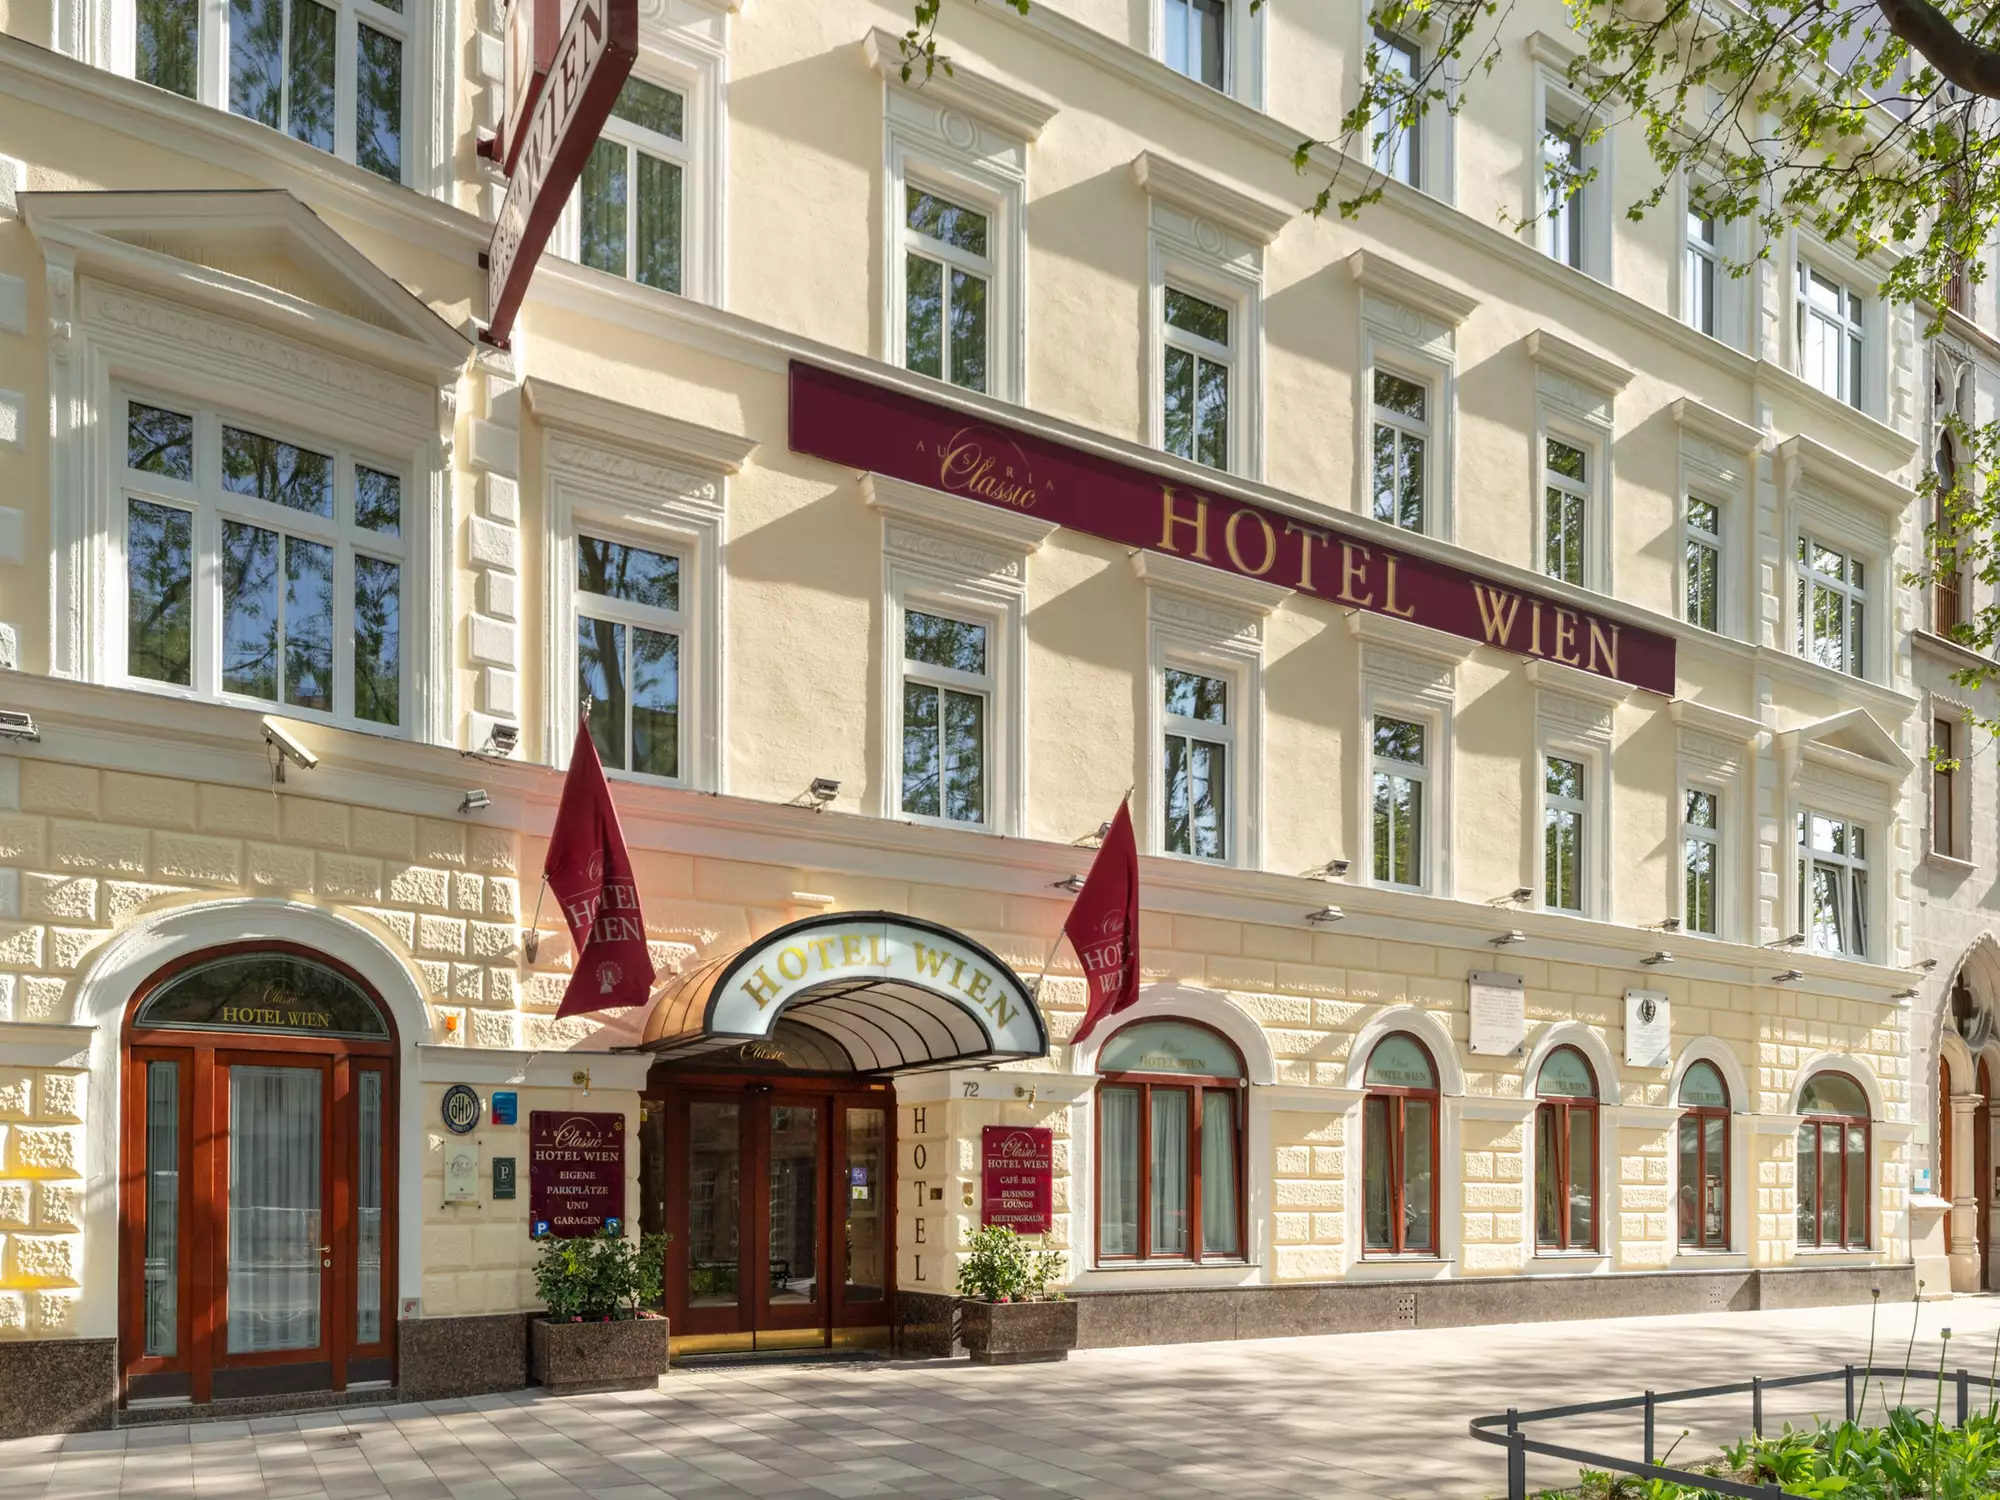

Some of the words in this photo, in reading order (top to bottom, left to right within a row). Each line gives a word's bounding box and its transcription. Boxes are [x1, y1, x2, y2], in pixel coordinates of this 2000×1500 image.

[941, 442, 1036, 508] Classic
[1157, 484, 1415, 619] HOTEL
[1470, 580, 1621, 678] WIEN
[582, 917, 641, 951] IEN
[1084, 942, 1124, 971] HOT
[740, 934, 891, 1011] HOTEL
[912, 942, 1020, 1030] WIEN
[222, 1007, 285, 1025] HOTEL
[288, 1011, 330, 1027] WIEN
[963, 1082, 979, 1097] 72
[556, 1125, 602, 1148] Classic
[1002, 1139, 1037, 1157] Classic
[535, 1150, 580, 1161] HOTEL
[584, 1151, 619, 1161] WIEN
[987, 1159, 1020, 1168] HOTEL
[1023, 1160, 1049, 1169] WIEN
[560, 1171, 596, 1180] EIGENE
[1000, 1175, 1019, 1184] CAFÉ
[1022, 1176, 1036, 1184] BAR
[547, 1185, 609, 1195] PARKPLÄTZE
[914, 1107, 927, 1281] HOTEL
[1001, 1190, 1035, 1198] BUSINESS
[566, 1201, 589, 1210] UND
[553, 1216, 600, 1225] GARAGEN
[991, 1214, 1045, 1222] MEETINGRAUM
[538, 1222, 547, 1234] P
